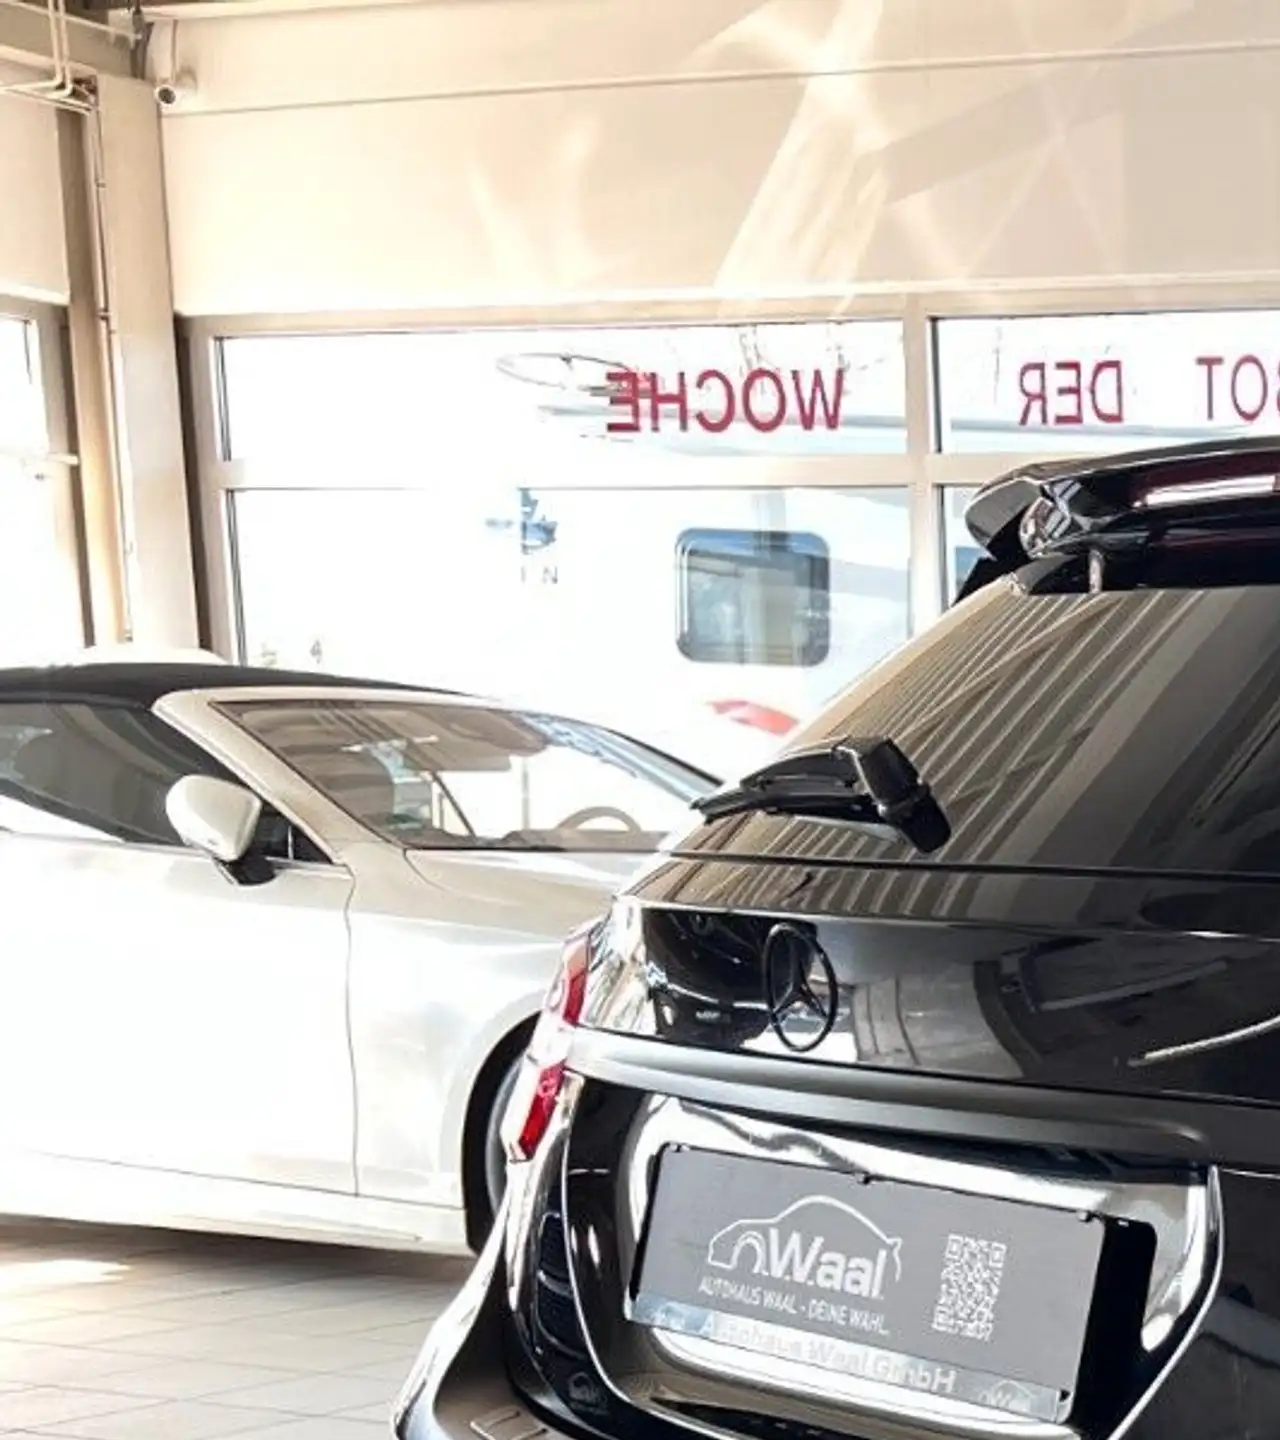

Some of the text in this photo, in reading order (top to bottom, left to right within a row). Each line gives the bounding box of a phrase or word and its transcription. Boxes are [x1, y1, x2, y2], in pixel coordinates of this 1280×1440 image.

[768, 1227, 888, 1301] Waal
[699, 1275, 761, 1306] AUTOHAUS
[762, 1288, 798, 1315] WAAL
[808, 1298, 848, 1325] DEINE
[872, 1351, 956, 1395] GmbH
